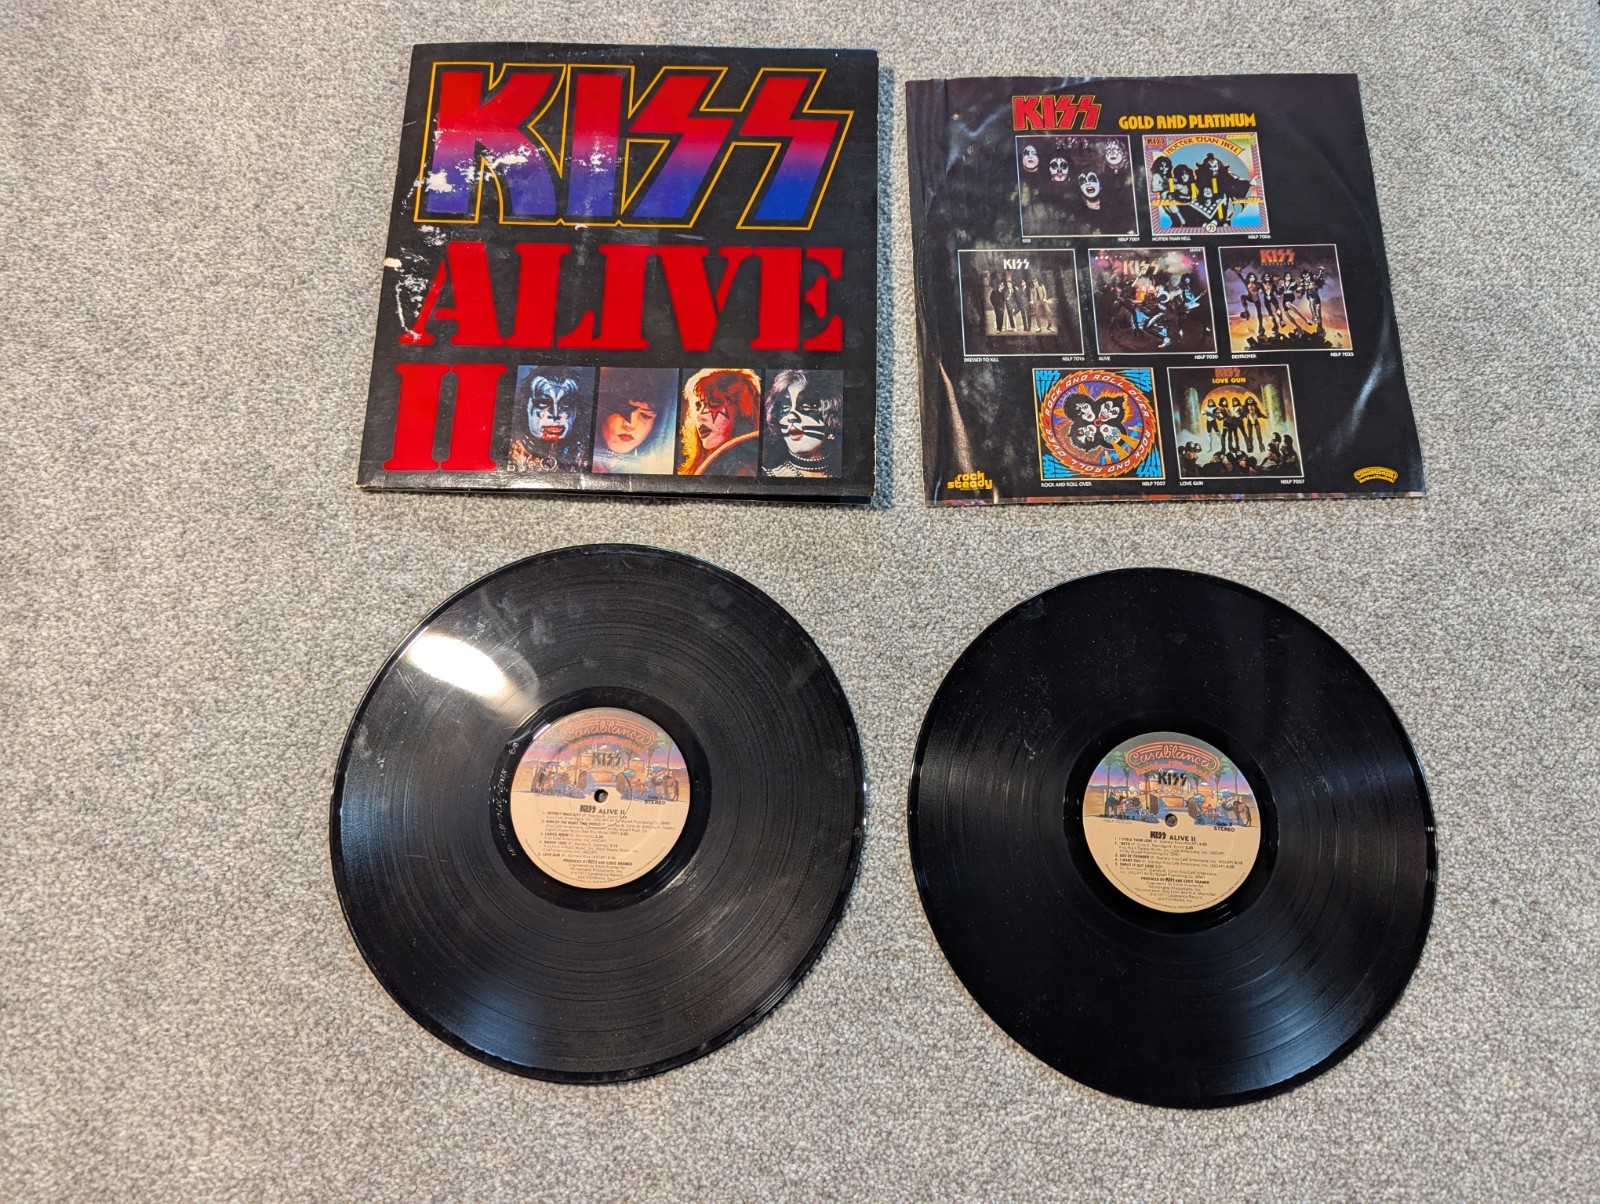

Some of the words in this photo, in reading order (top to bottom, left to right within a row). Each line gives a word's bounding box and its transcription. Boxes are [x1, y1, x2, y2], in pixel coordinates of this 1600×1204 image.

[1012, 95, 1102, 131] KISS
[1118, 115, 1154, 130] GOLD
[1156, 114, 1187, 129] AND
[1188, 113, 1256, 129] PLATINUM
[414, 62, 854, 230] KISS
[1166, 137, 1194, 154] HOTTER
[1195, 136, 1218, 144] THAN
[1220, 140, 1239, 154] HELL
[1260, 248, 1296, 262] KISS
[1003, 259, 1030, 270] KISS
[1123, 260, 1160, 275] KISS
[398, 241, 843, 351] ALIVE
[1044, 387, 1062, 416] ROCK
[1066, 374, 1088, 388] AND
[1093, 374, 1124, 388] ROLL
[1128, 390, 1150, 417] OVER
[383, 363, 507, 472] II
[956, 470, 984, 481] rock
[947, 479, 993, 490] steady
[563, 719, 650, 745] Casablanca
[592, 752, 622, 766] KISS
[1128, 744, 1212, 770] Casablanca
[1158, 772, 1186, 786] KISS
[580, 805, 596, 813] KISS
[1150, 831, 1166, 839] KISS
